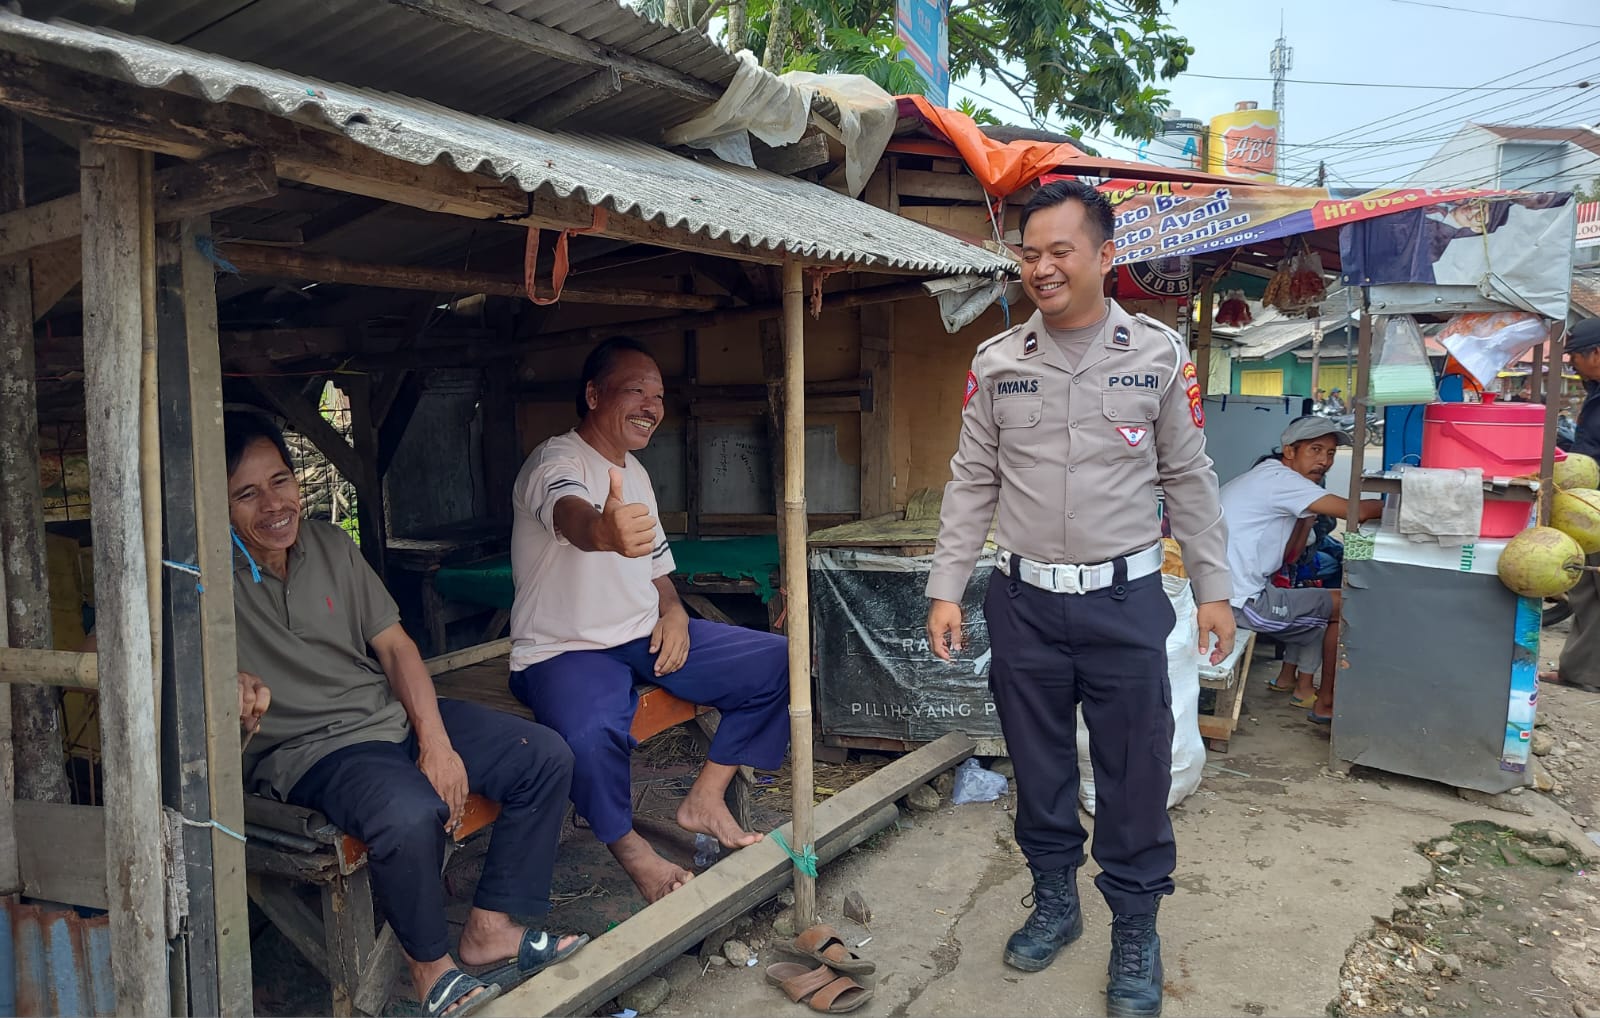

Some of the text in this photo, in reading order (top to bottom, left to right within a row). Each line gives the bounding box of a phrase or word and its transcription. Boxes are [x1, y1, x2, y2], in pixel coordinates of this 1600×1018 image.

[1228, 136, 1273, 163] ABC
[1114, 206, 1149, 230] oto
[1115, 198, 1228, 250] oto Ayam
[1114, 214, 1249, 264] oto Ranjau
[1142, 272, 1188, 292] BUBB
[997, 379, 1039, 395] YAYAN.S
[1108, 374, 1159, 389] POLRI
[852, 702, 902, 718] PILIH
[913, 703, 971, 718] YANG
